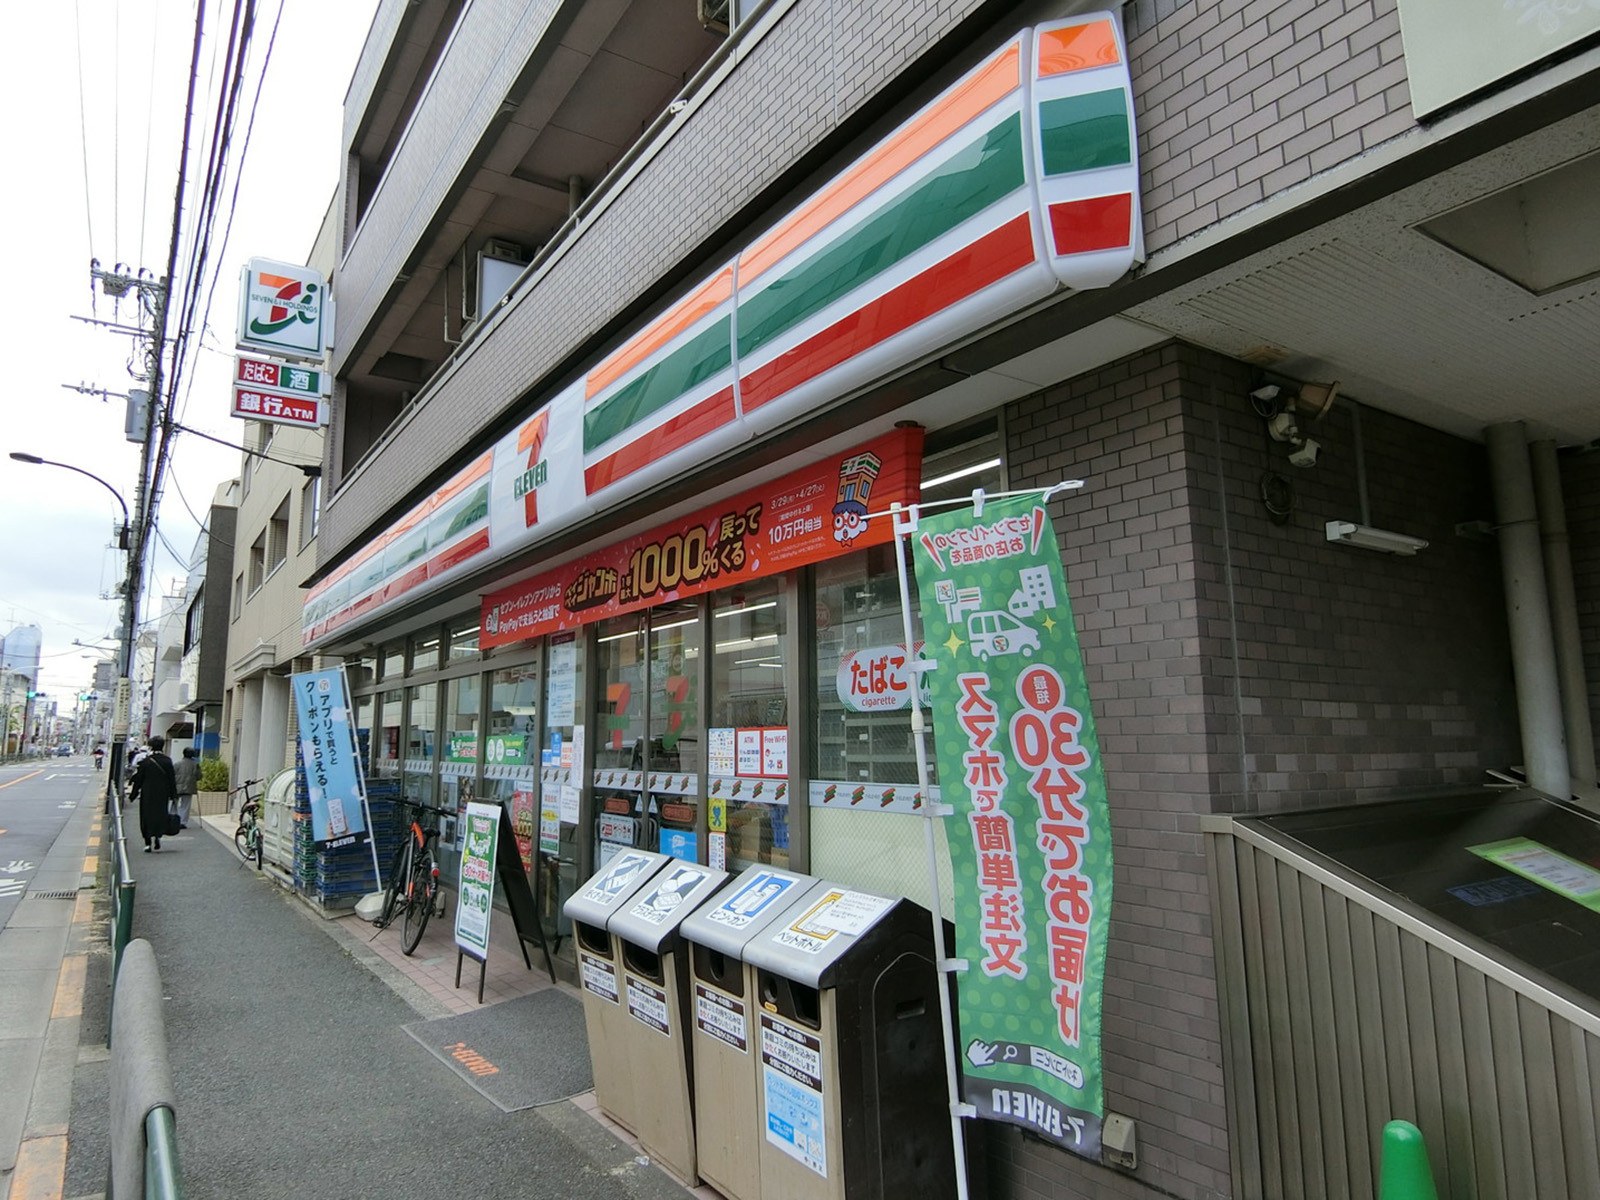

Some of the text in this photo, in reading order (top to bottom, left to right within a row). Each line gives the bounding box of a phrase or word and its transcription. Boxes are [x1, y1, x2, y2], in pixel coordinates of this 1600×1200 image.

[244, 362, 311, 390] たばこ 酒
[720, 505, 761, 541] 戻って
[768, 516, 822, 545] 10万円相当
[720, 541, 745, 569] くる
[850, 655, 908, 696] たばこ
[861, 695, 897, 708] cigarette
[320, 694, 338, 766] アプリで買うと
[777, 931, 822, 952] ペットボトル
